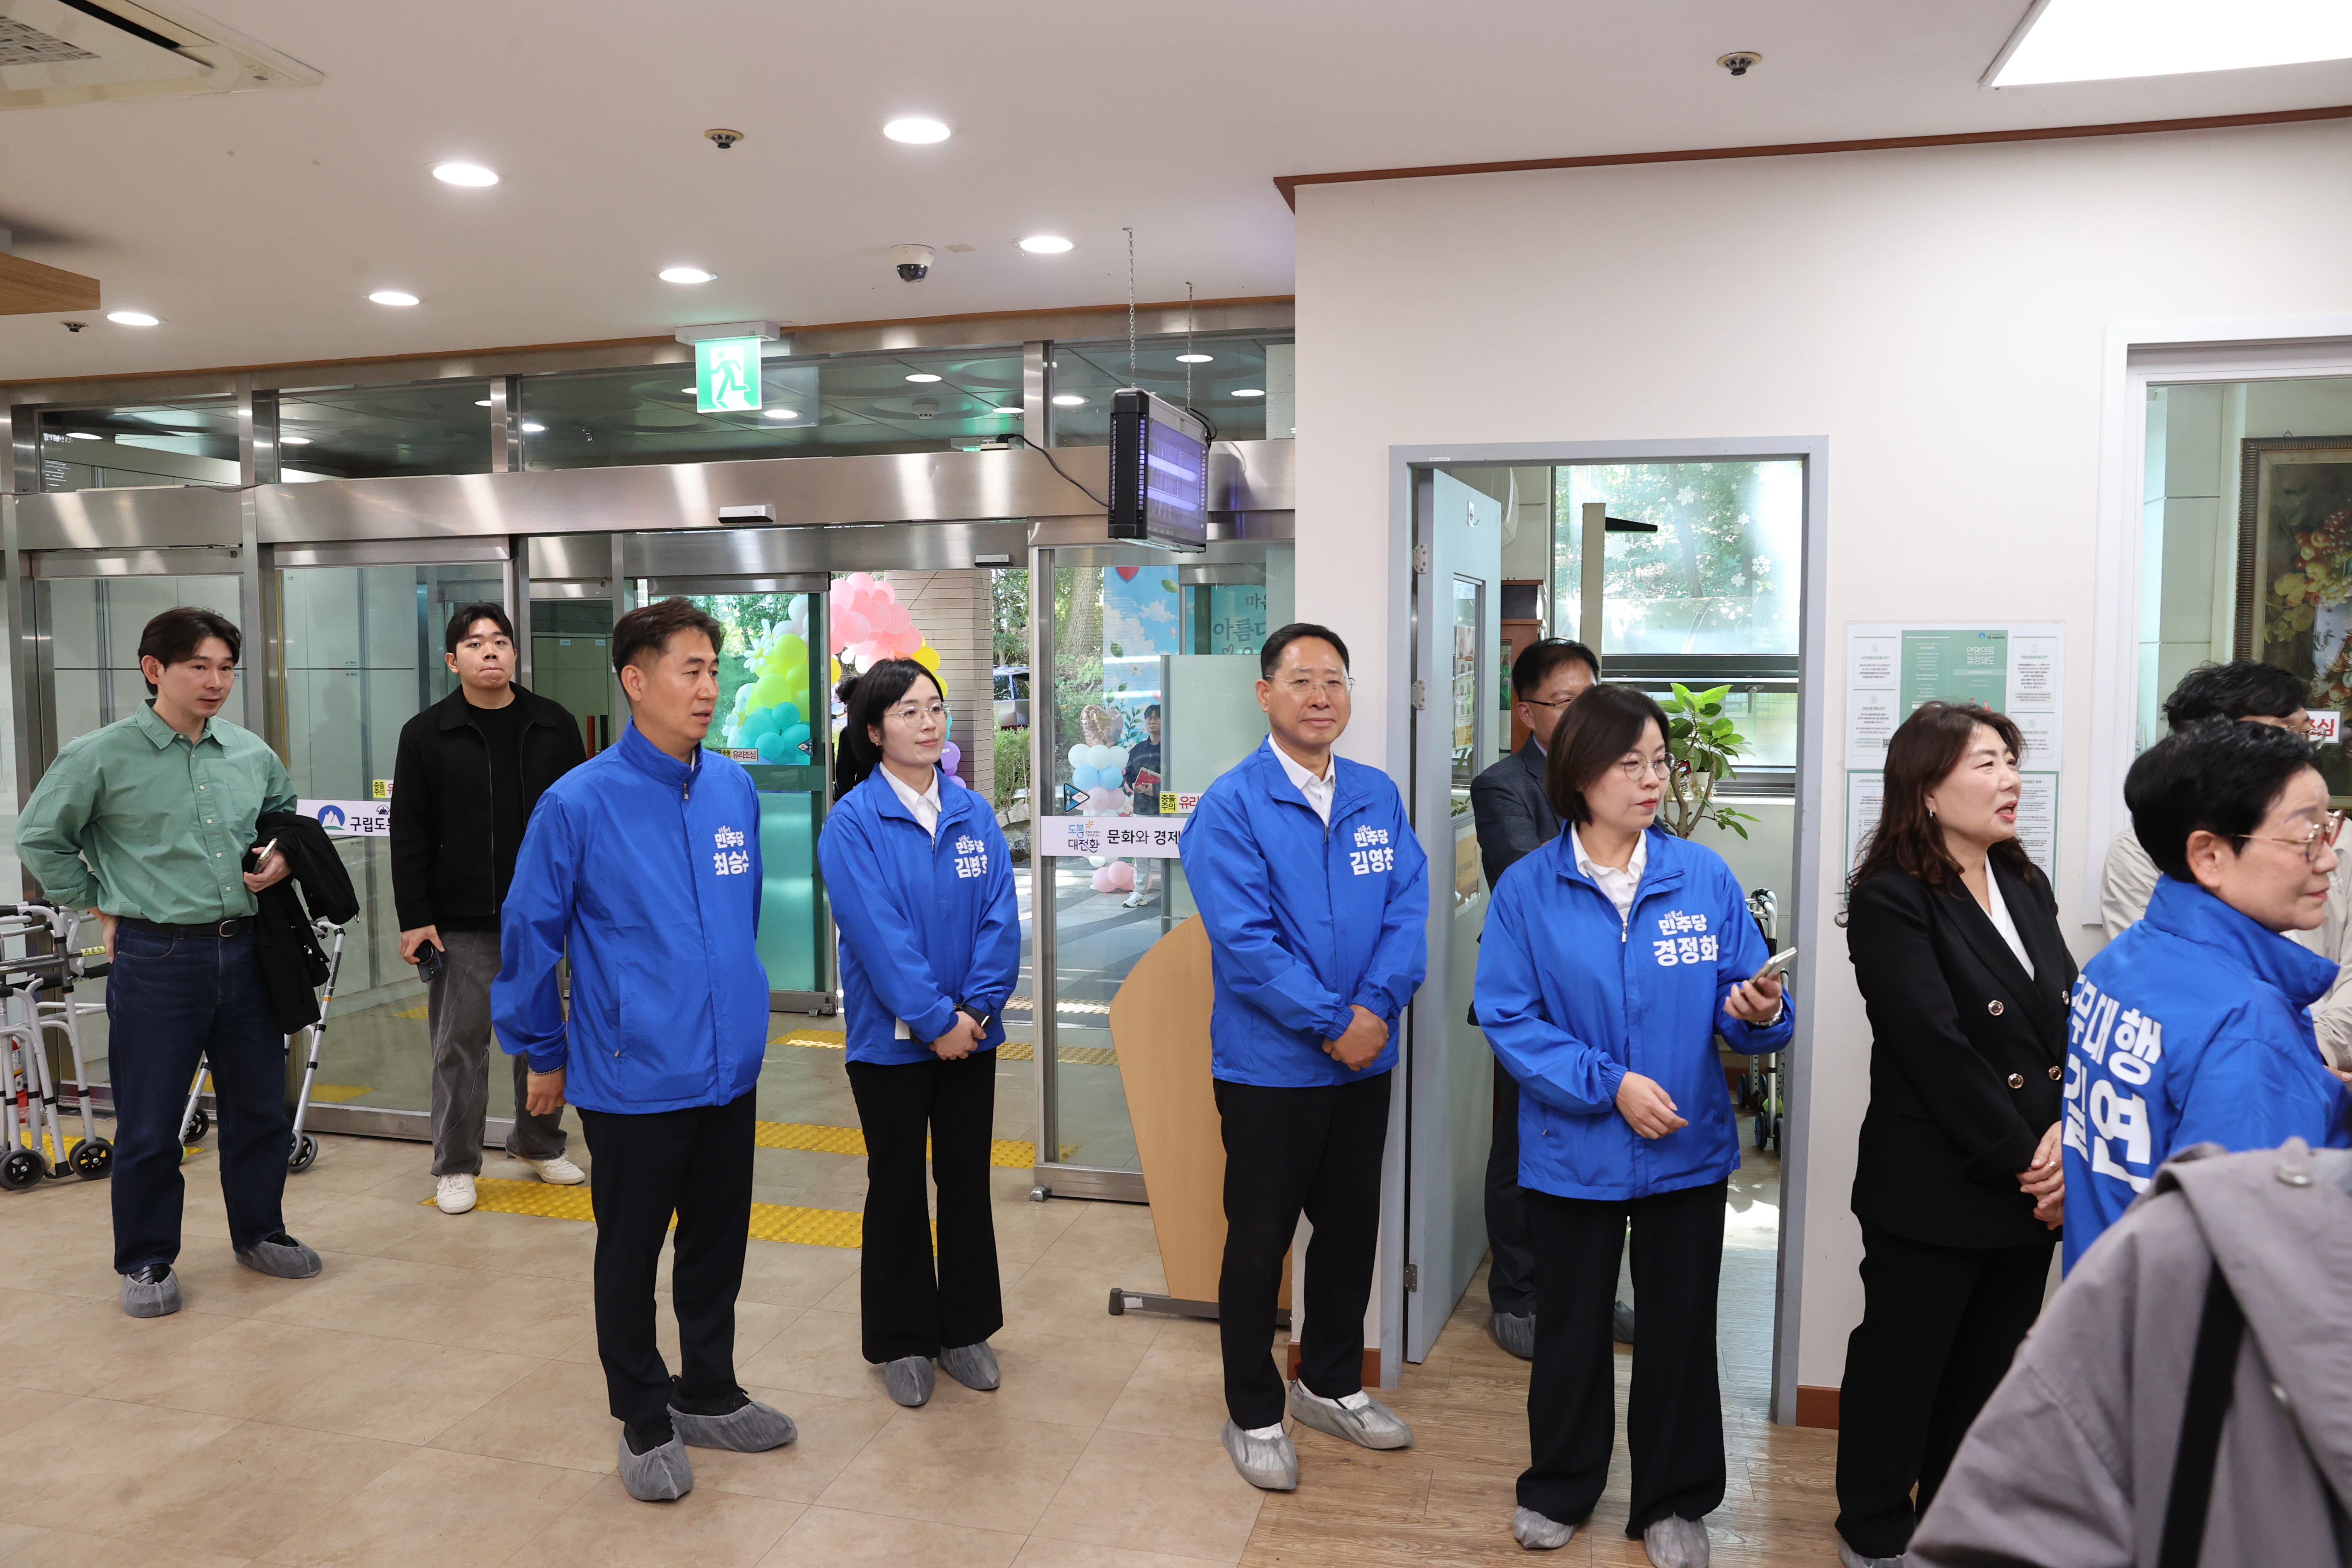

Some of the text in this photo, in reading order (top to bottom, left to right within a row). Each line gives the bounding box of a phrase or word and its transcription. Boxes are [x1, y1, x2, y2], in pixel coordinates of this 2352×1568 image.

[1966, 646, 1995, 655] 연명의료
[1966, 656, 1995, 665] 결정제도
[732, 750, 756, 760] 유리조심
[1161, 794, 1176, 803] 충돌
[1161, 802, 1176, 811] 주의
[1068, 823, 1084, 839] 도봉
[1107, 830, 1181, 845] 문화와 경제
[1354, 829, 1389, 848] 민주당
[714, 831, 744, 849] 민주당
[955, 839, 985, 855] 민주당
[1068, 838, 1100, 853] 대전환
[713, 850, 749, 876] 최승수
[1658, 914, 1707, 936] 민주당
[1653, 934, 1719, 967] 경정화
[2071, 973, 2162, 1086] 무대행
